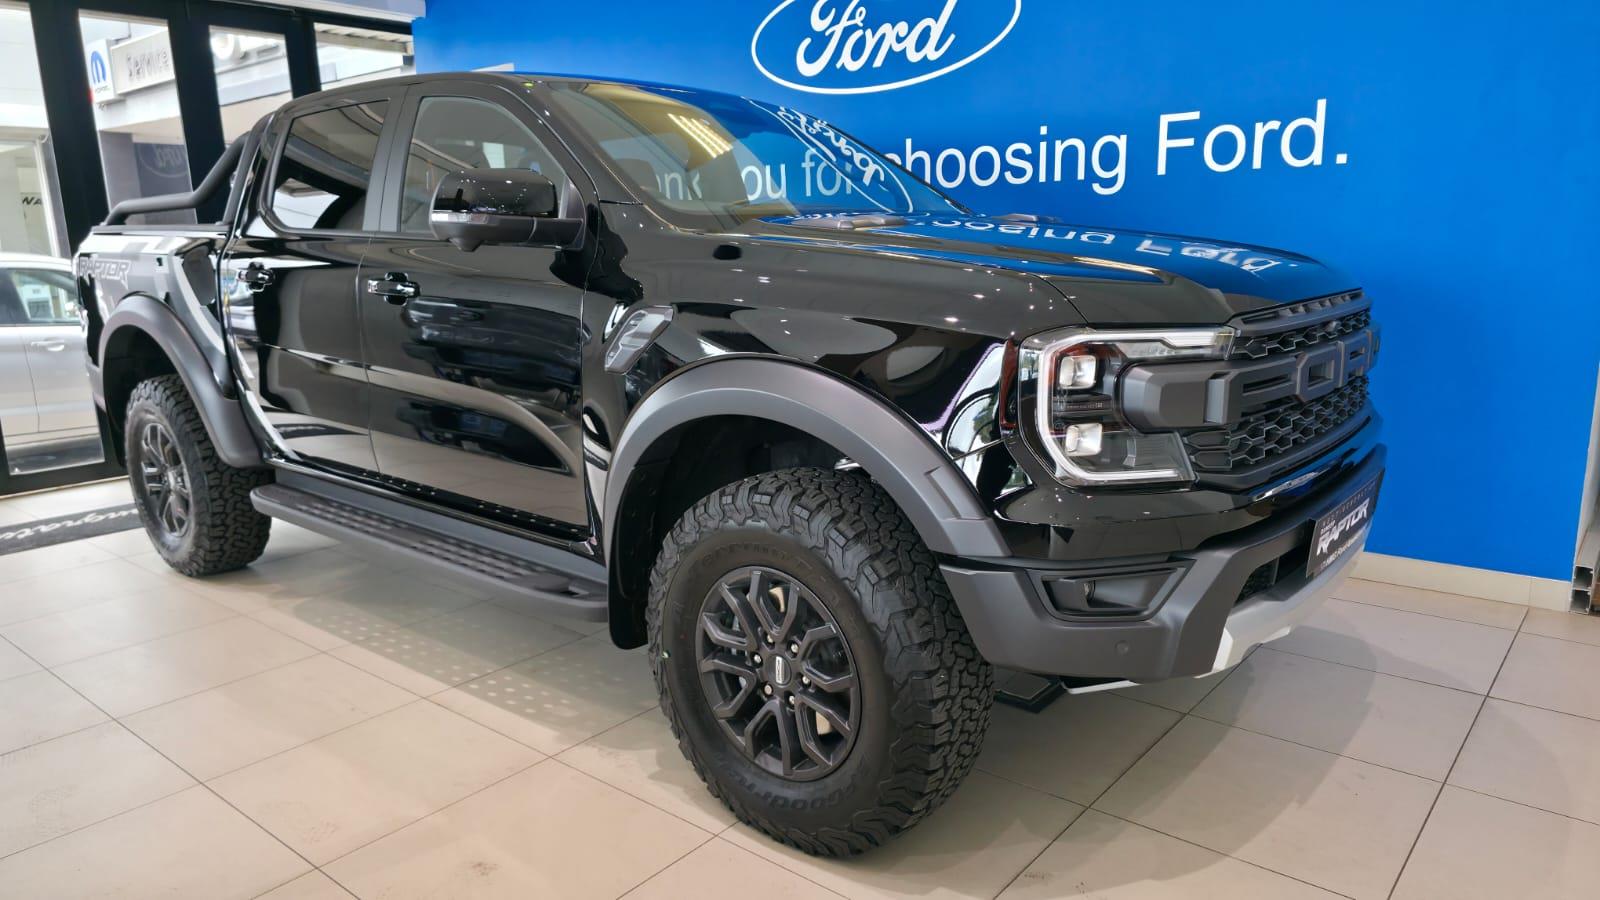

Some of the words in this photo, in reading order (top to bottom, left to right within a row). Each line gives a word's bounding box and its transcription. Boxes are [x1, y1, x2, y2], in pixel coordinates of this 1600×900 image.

[795, 0, 957, 77] Ford
[743, 163, 788, 201] ou
[884, 125, 1130, 197] hoosing
[1157, 99, 1348, 175] Ford.
[77, 256, 131, 290] RAPTOR
[1206, 330, 1380, 426] FOR
[1316, 497, 1370, 556] RAPTOR
